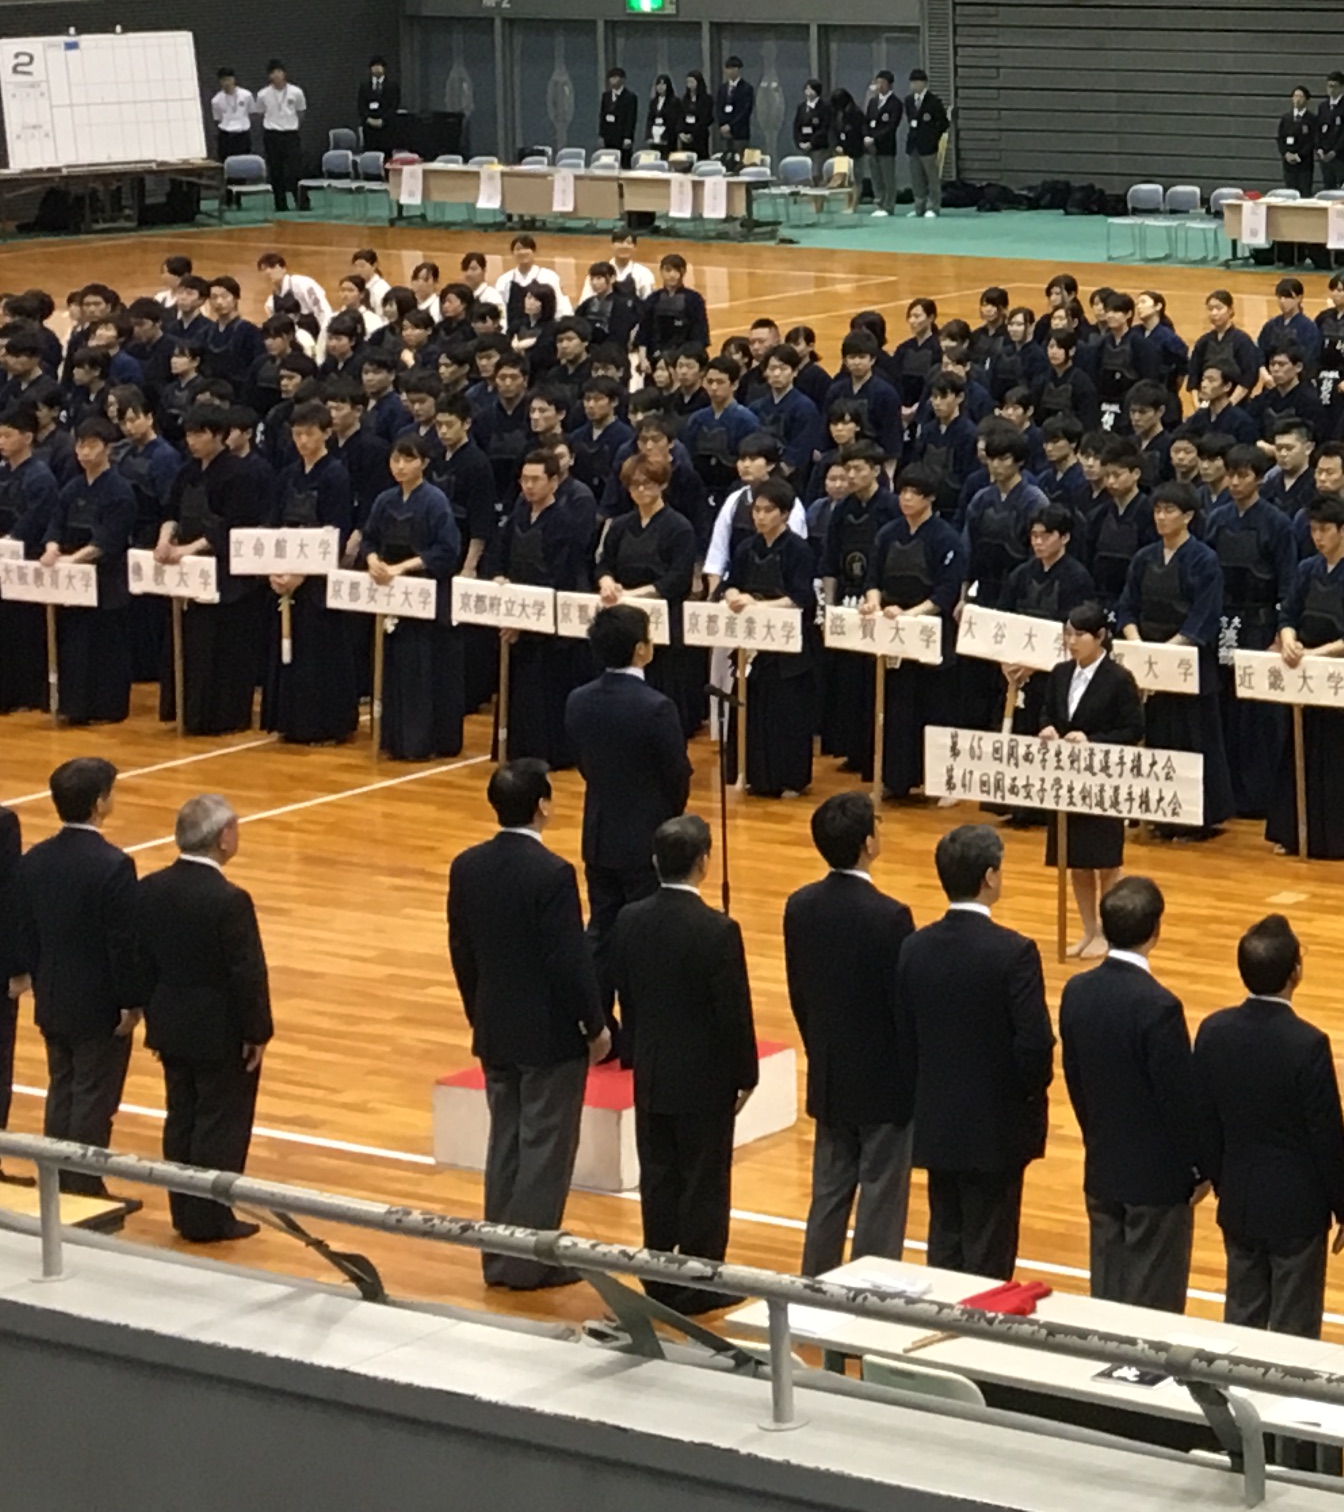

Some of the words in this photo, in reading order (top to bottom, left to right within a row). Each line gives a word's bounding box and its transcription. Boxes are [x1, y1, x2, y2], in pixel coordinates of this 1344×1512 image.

[12, 51, 34, 76] 2
[231, 536, 333, 561] 立命館大学
[329, 578, 433, 611] 京都女子大学
[458, 591, 547, 622] 京都府立大学
[687, 610, 797, 646] 京都産業大学
[828, 611, 937, 650] 滋賀大学
[1237, 664, 1344, 697] 近畿大学
